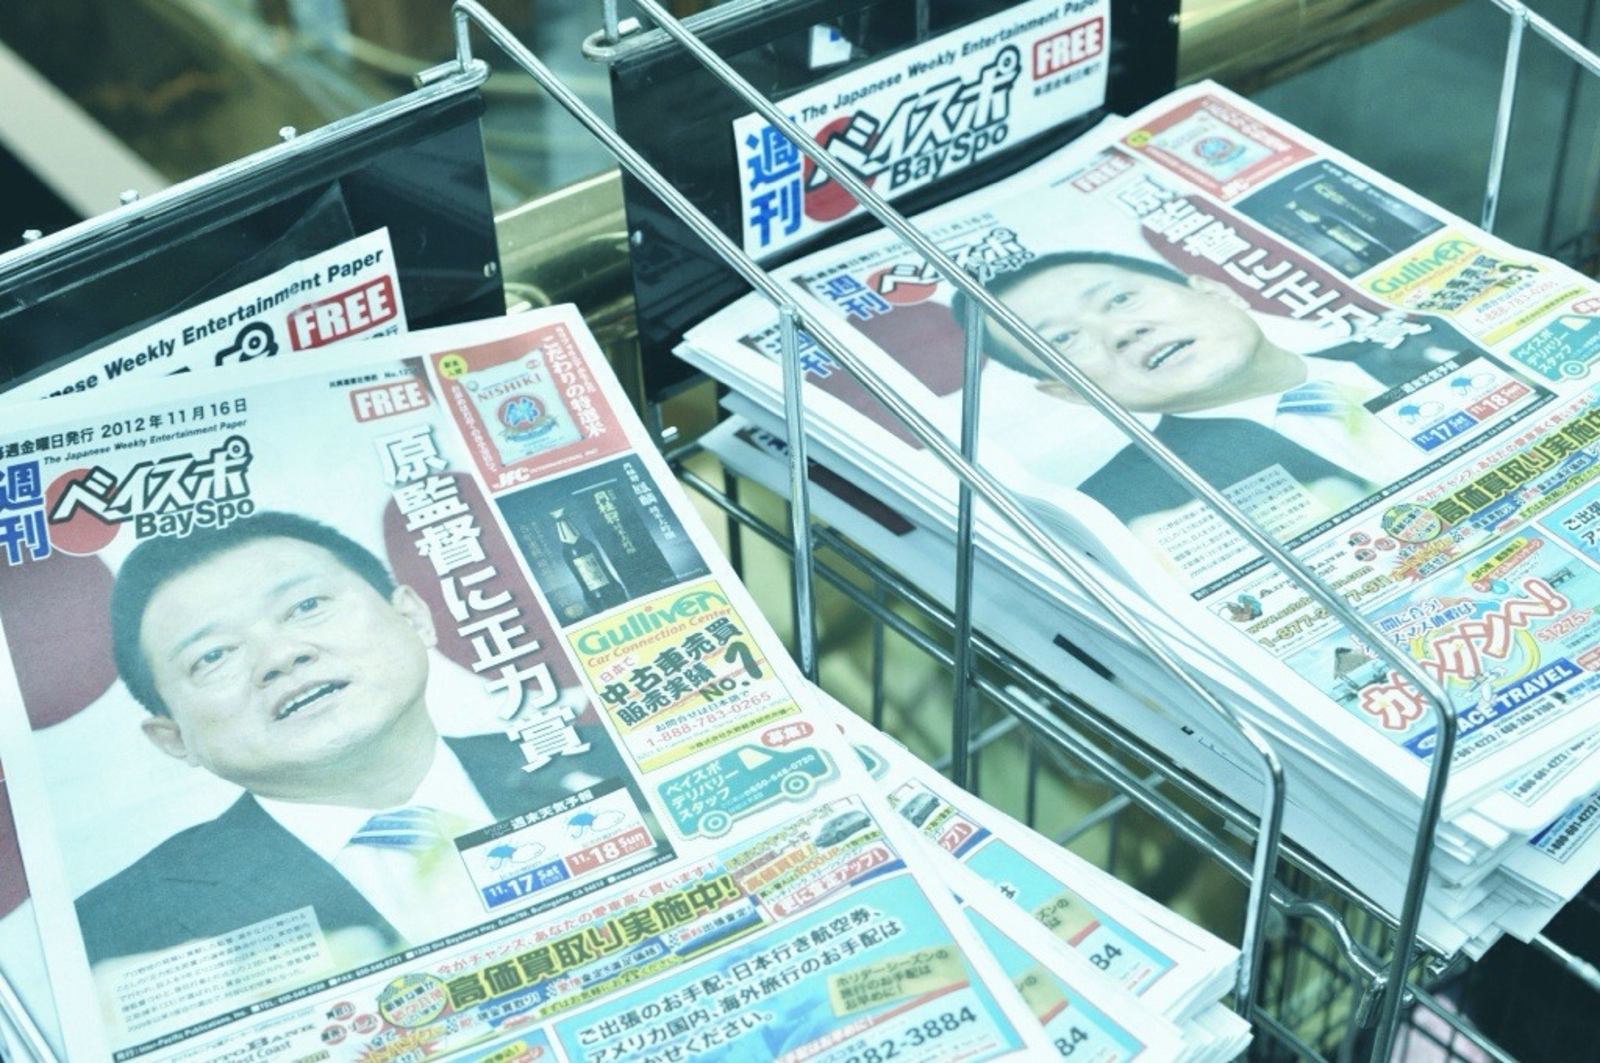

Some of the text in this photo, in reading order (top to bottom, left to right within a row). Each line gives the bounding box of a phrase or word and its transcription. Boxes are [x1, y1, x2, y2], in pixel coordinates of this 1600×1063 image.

[800, 105, 828, 123] The
[833, 73, 902, 111] Japanese
[907, 49, 956, 79] Weekly
[961, 8, 1059, 57] Entertainment
[1037, 20, 1102, 76] FREE
[804, 45, 1021, 192] ベイスポ
[888, 124, 1010, 190] BaySpo
[1114, 173, 1431, 349] 原監督に正力賞
[1369, 240, 1480, 294] Gulliver
[103, 336, 175, 380] Weekly
[181, 275, 321, 347] Entertainment
[327, 249, 384, 283] Paper
[293, 280, 395, 350] FREE
[817, 274, 894, 321] 週刊
[354, 382, 427, 419] FREE
[477, 374, 543, 403] NISHIKI
[44, 419, 247, 466] The Japanese Weekly Entertainment Paper
[49, 435, 253, 526] ベイスポ
[498, 466, 531, 488] JFC
[135, 499, 254, 539] BaySpo
[379, 424, 592, 774] 原監督に正力賞
[577, 590, 729, 656] Gulliver
[587, 607, 732, 670] Car Connection Center
[600, 616, 743, 706] 中古車売買
[616, 662, 716, 727] 販売実績
[1498, 666, 1573, 708] TRAVEL
[646, 691, 772, 747] 1-888-783-0265
[667, 760, 723, 796] ベイスポ
[673, 769, 740, 810] デリバリー
[678, 786, 730, 823] スタッフ
[510, 789, 595, 830] 週末天気予報
[618, 832, 644, 848] Sun
[537, 865, 559, 880] Sat
[449, 874, 741, 1010] 高価買取り実施中!
[1089, 943, 1123, 971] 84
[578, 906, 884, 1045] ご出張のお手配、日本行き航空券、
[1056, 1025, 1089, 1057] 84
